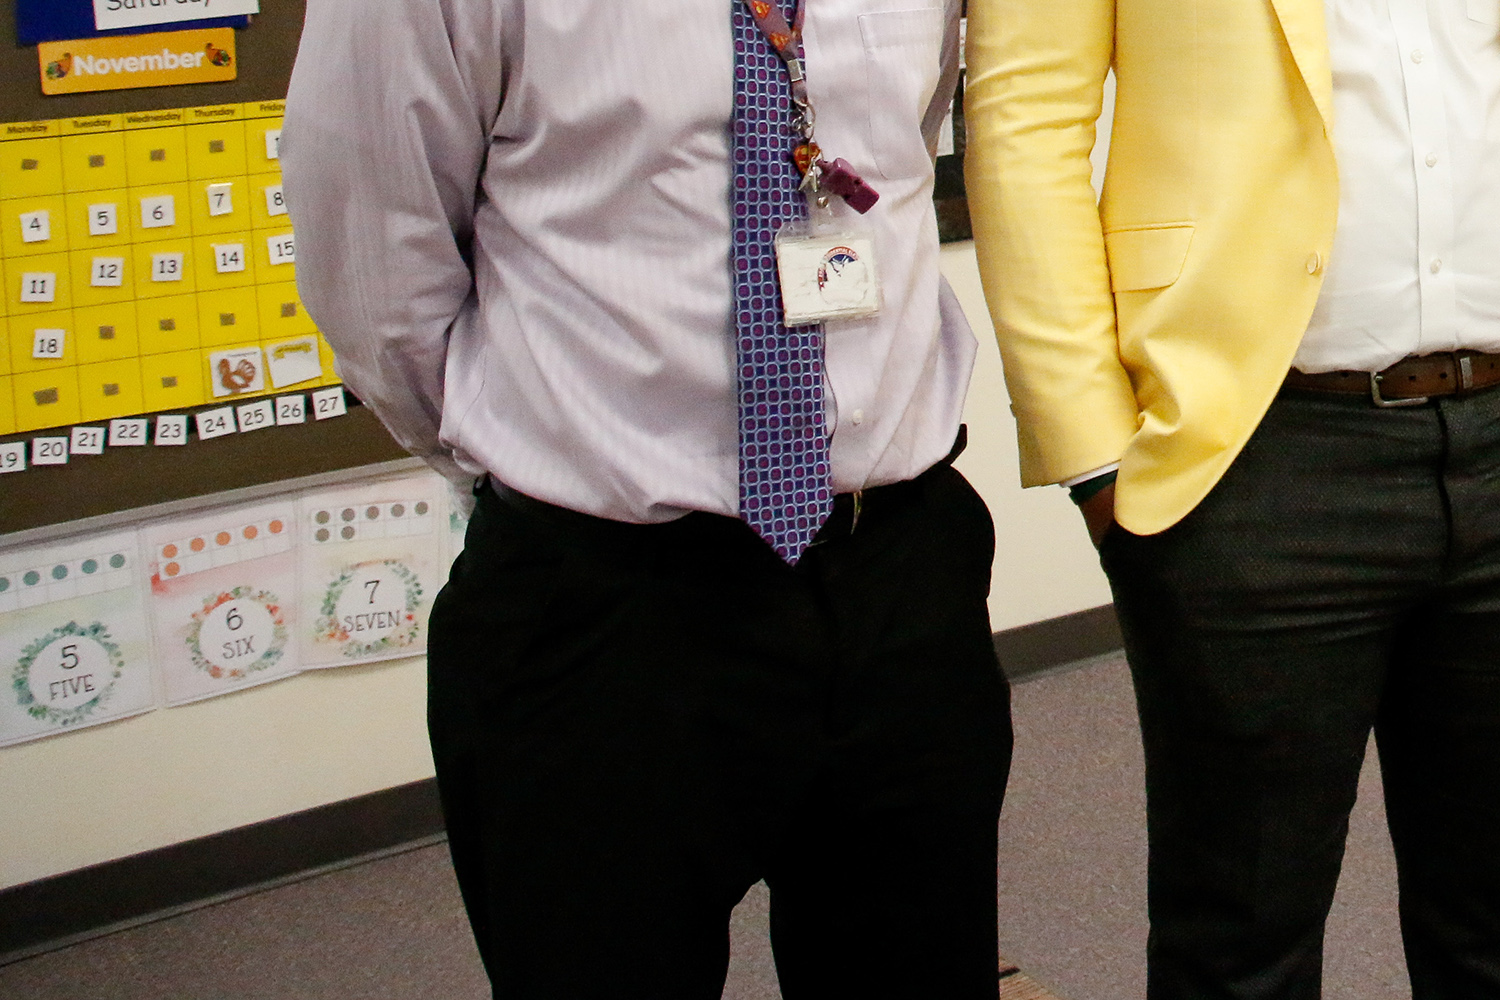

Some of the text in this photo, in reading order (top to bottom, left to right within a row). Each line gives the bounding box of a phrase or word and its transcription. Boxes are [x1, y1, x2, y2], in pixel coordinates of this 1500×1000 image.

[73, 47, 205, 77] November
[7, 124, 48, 135] Monday
[73, 118, 112, 130] Tuesday
[126, 112, 182, 124] Wednesday
[194, 108, 236, 119] Thursday
[30, 192, 284, 232] 4 5 6 7 8
[30, 242, 294, 294] 11 12 13 14 15
[38, 339, 58, 354] 18
[40, 442, 64, 458] 20
[78, 432, 98, 448] 21
[118, 424, 140, 439] 22
[160, 423, 182, 439] 23
[204, 416, 226, 433] 24
[244, 408, 265, 426] 25
[281, 404, 301, 419] 26
[319, 396, 339, 413] 27
[364, 580, 382, 604] 7
[226, 607, 244, 631] 6
[342, 610, 402, 635] SEVEN
[60, 644, 79, 670] 5
[222, 639, 256, 661] SIX
[49, 673, 96, 702] FIVE
